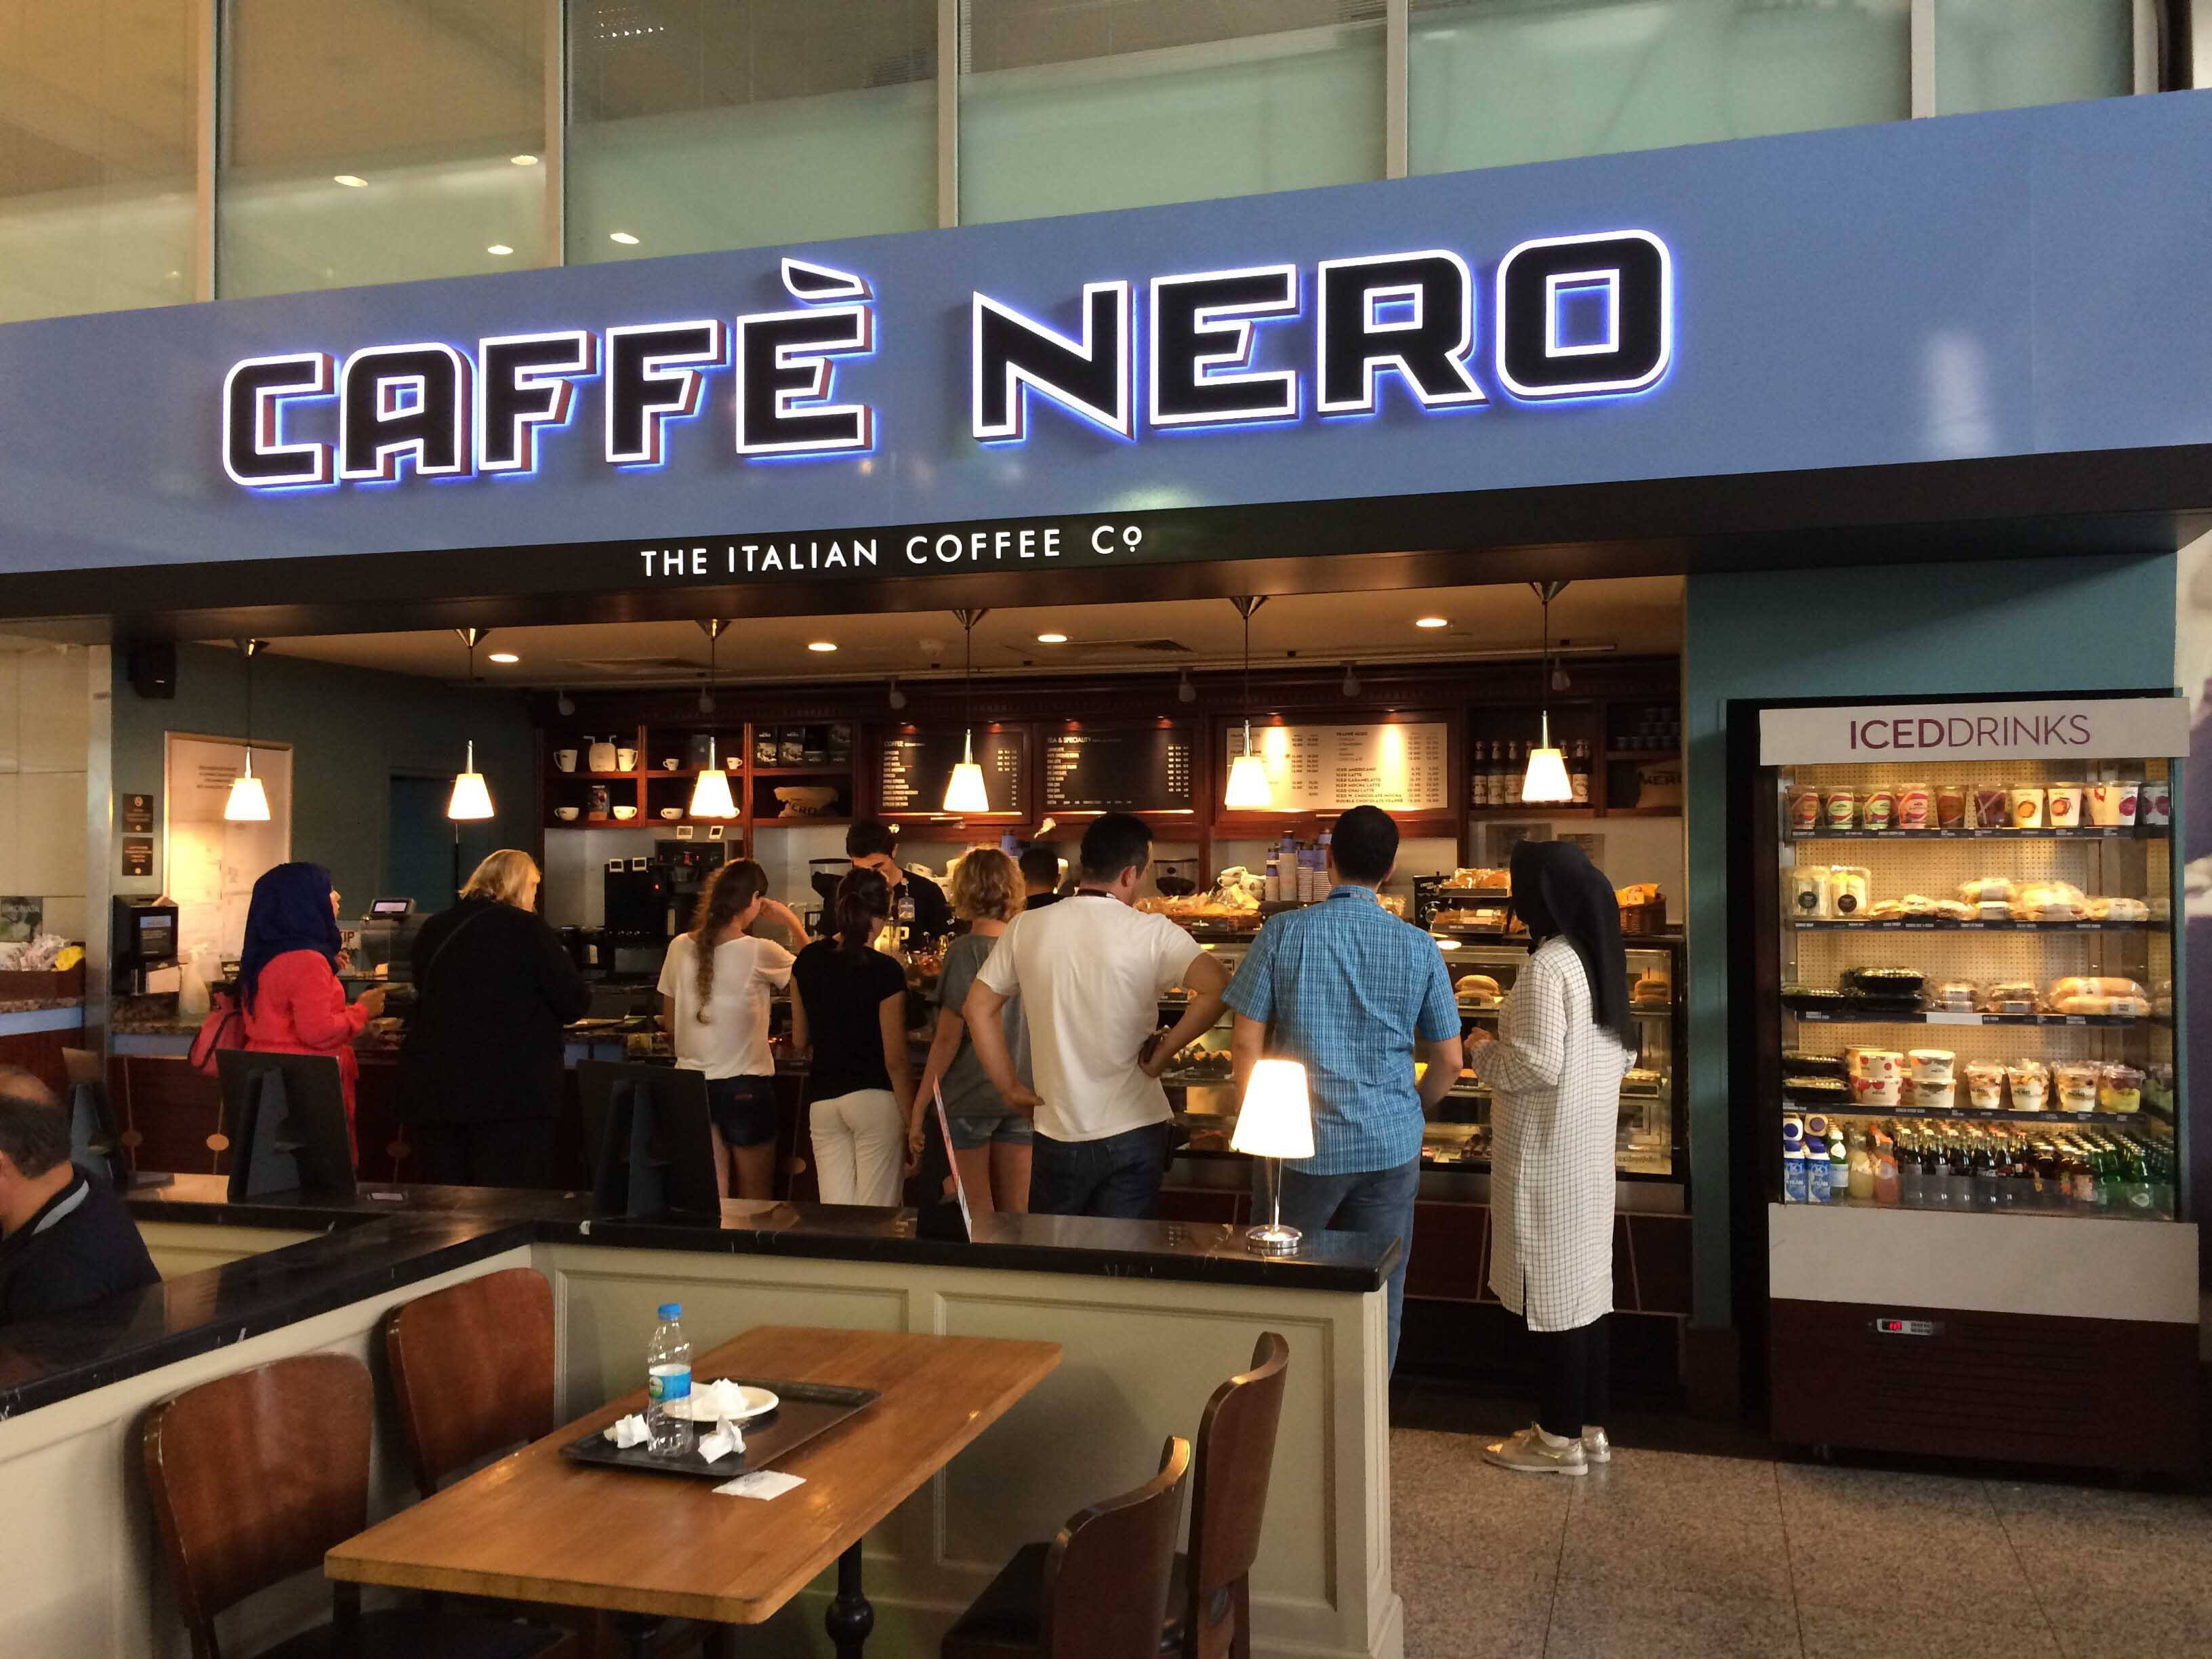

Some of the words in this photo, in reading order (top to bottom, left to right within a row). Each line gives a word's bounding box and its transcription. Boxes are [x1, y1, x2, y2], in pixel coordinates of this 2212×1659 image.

[971, 228, 1675, 442] NERO
[641, 548, 707, 577] THE
[726, 539, 878, 573] ITALIAN
[905, 527, 1060, 564] COFFEE
